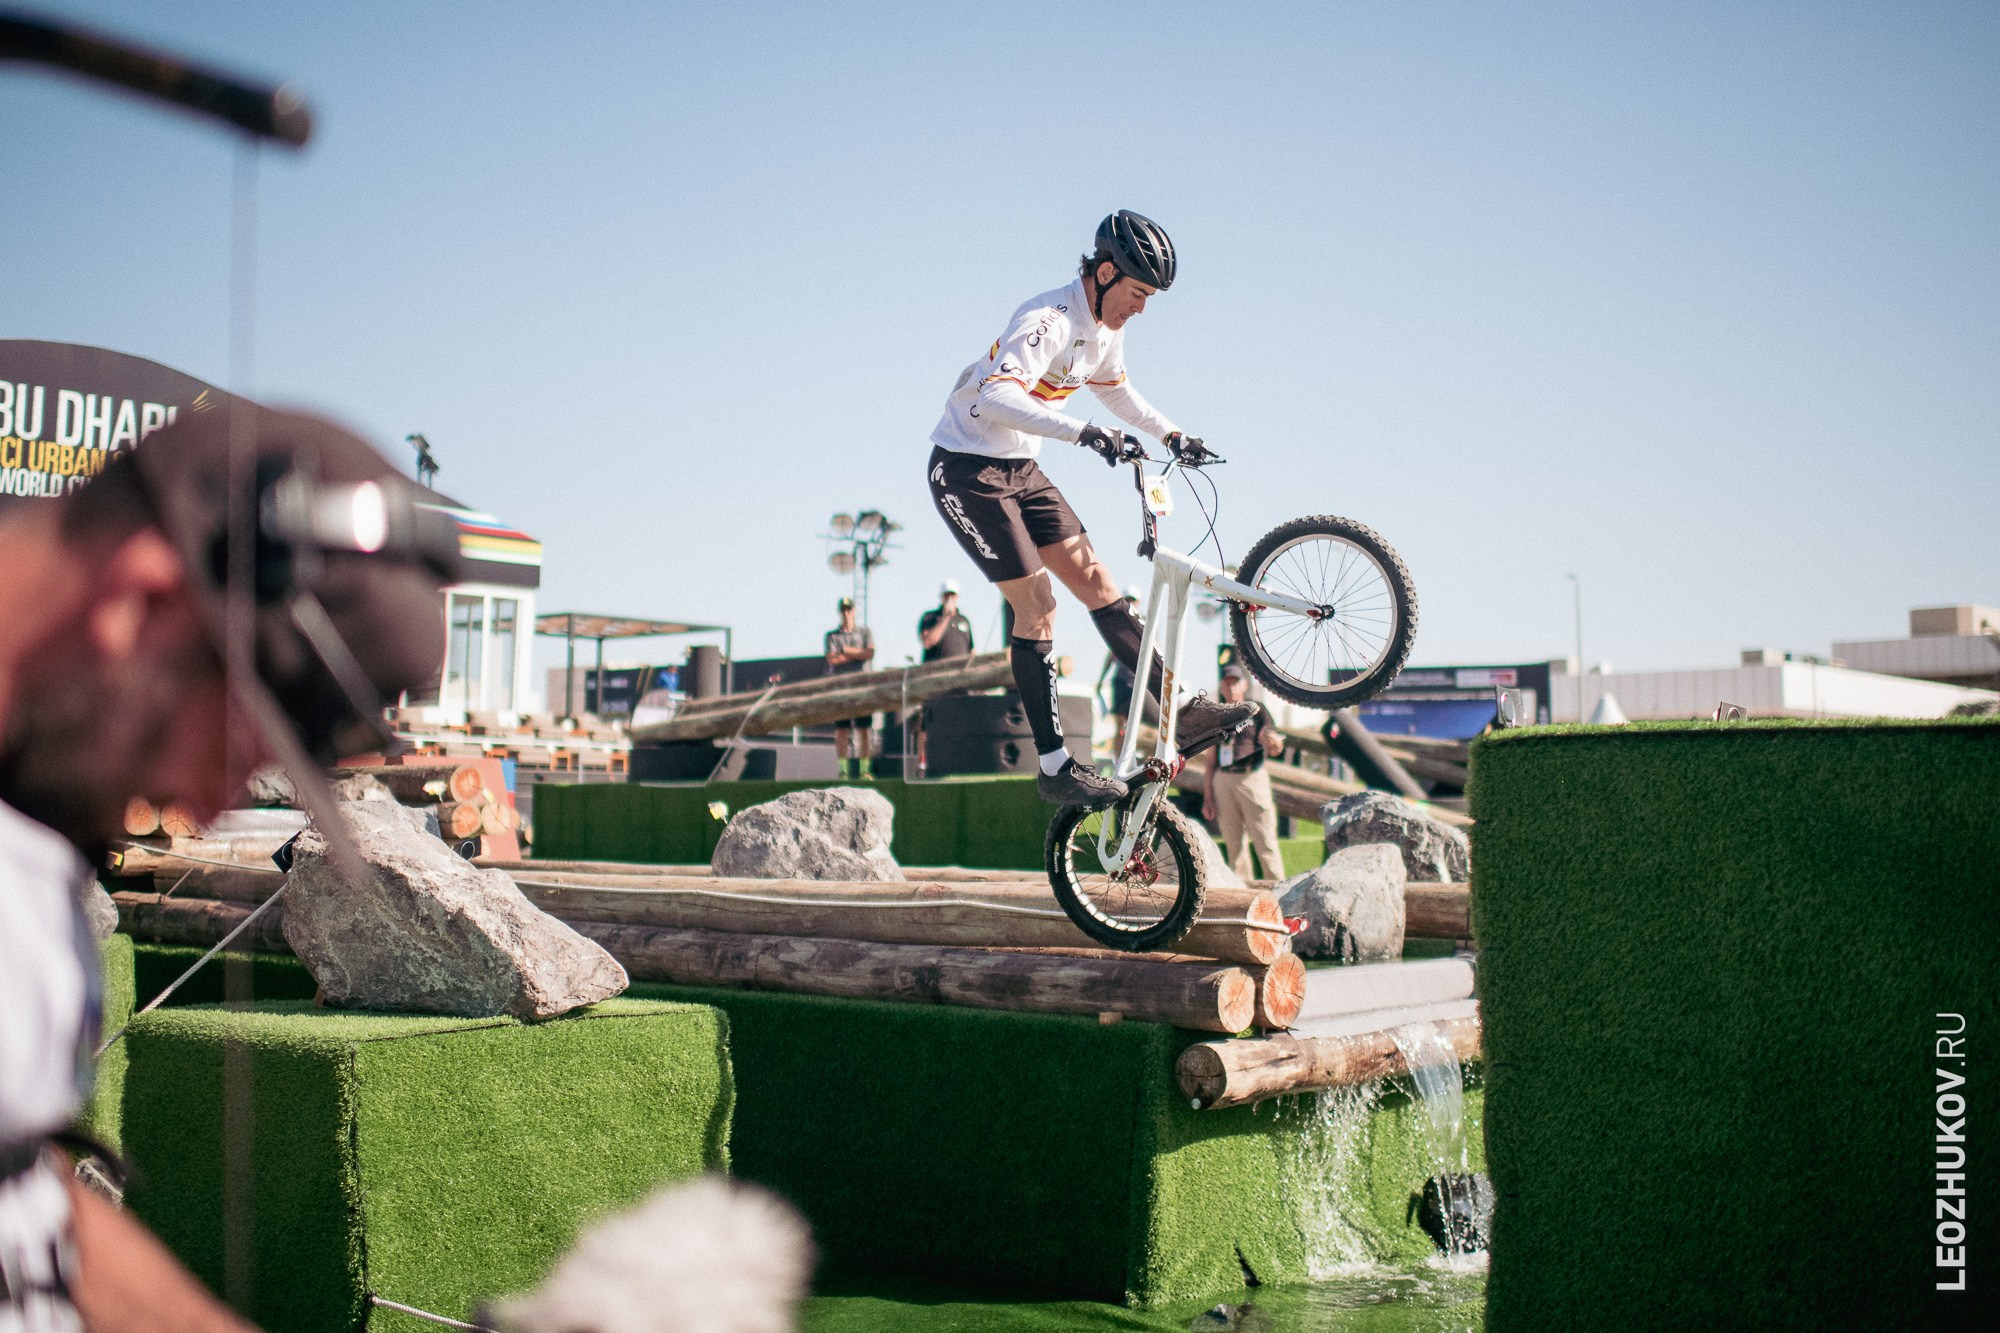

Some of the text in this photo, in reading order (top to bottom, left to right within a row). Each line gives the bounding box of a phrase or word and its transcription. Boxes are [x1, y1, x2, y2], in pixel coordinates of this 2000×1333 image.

[1026, 304, 1068, 347] Cofidis
[0, 436, 23, 470] CI
[0, 468, 64, 498] WORLD
[944, 494, 998, 559] CLEAN
[1048, 669, 1063, 736] CLEAN
[1161, 667, 1174, 743] CLEAN
